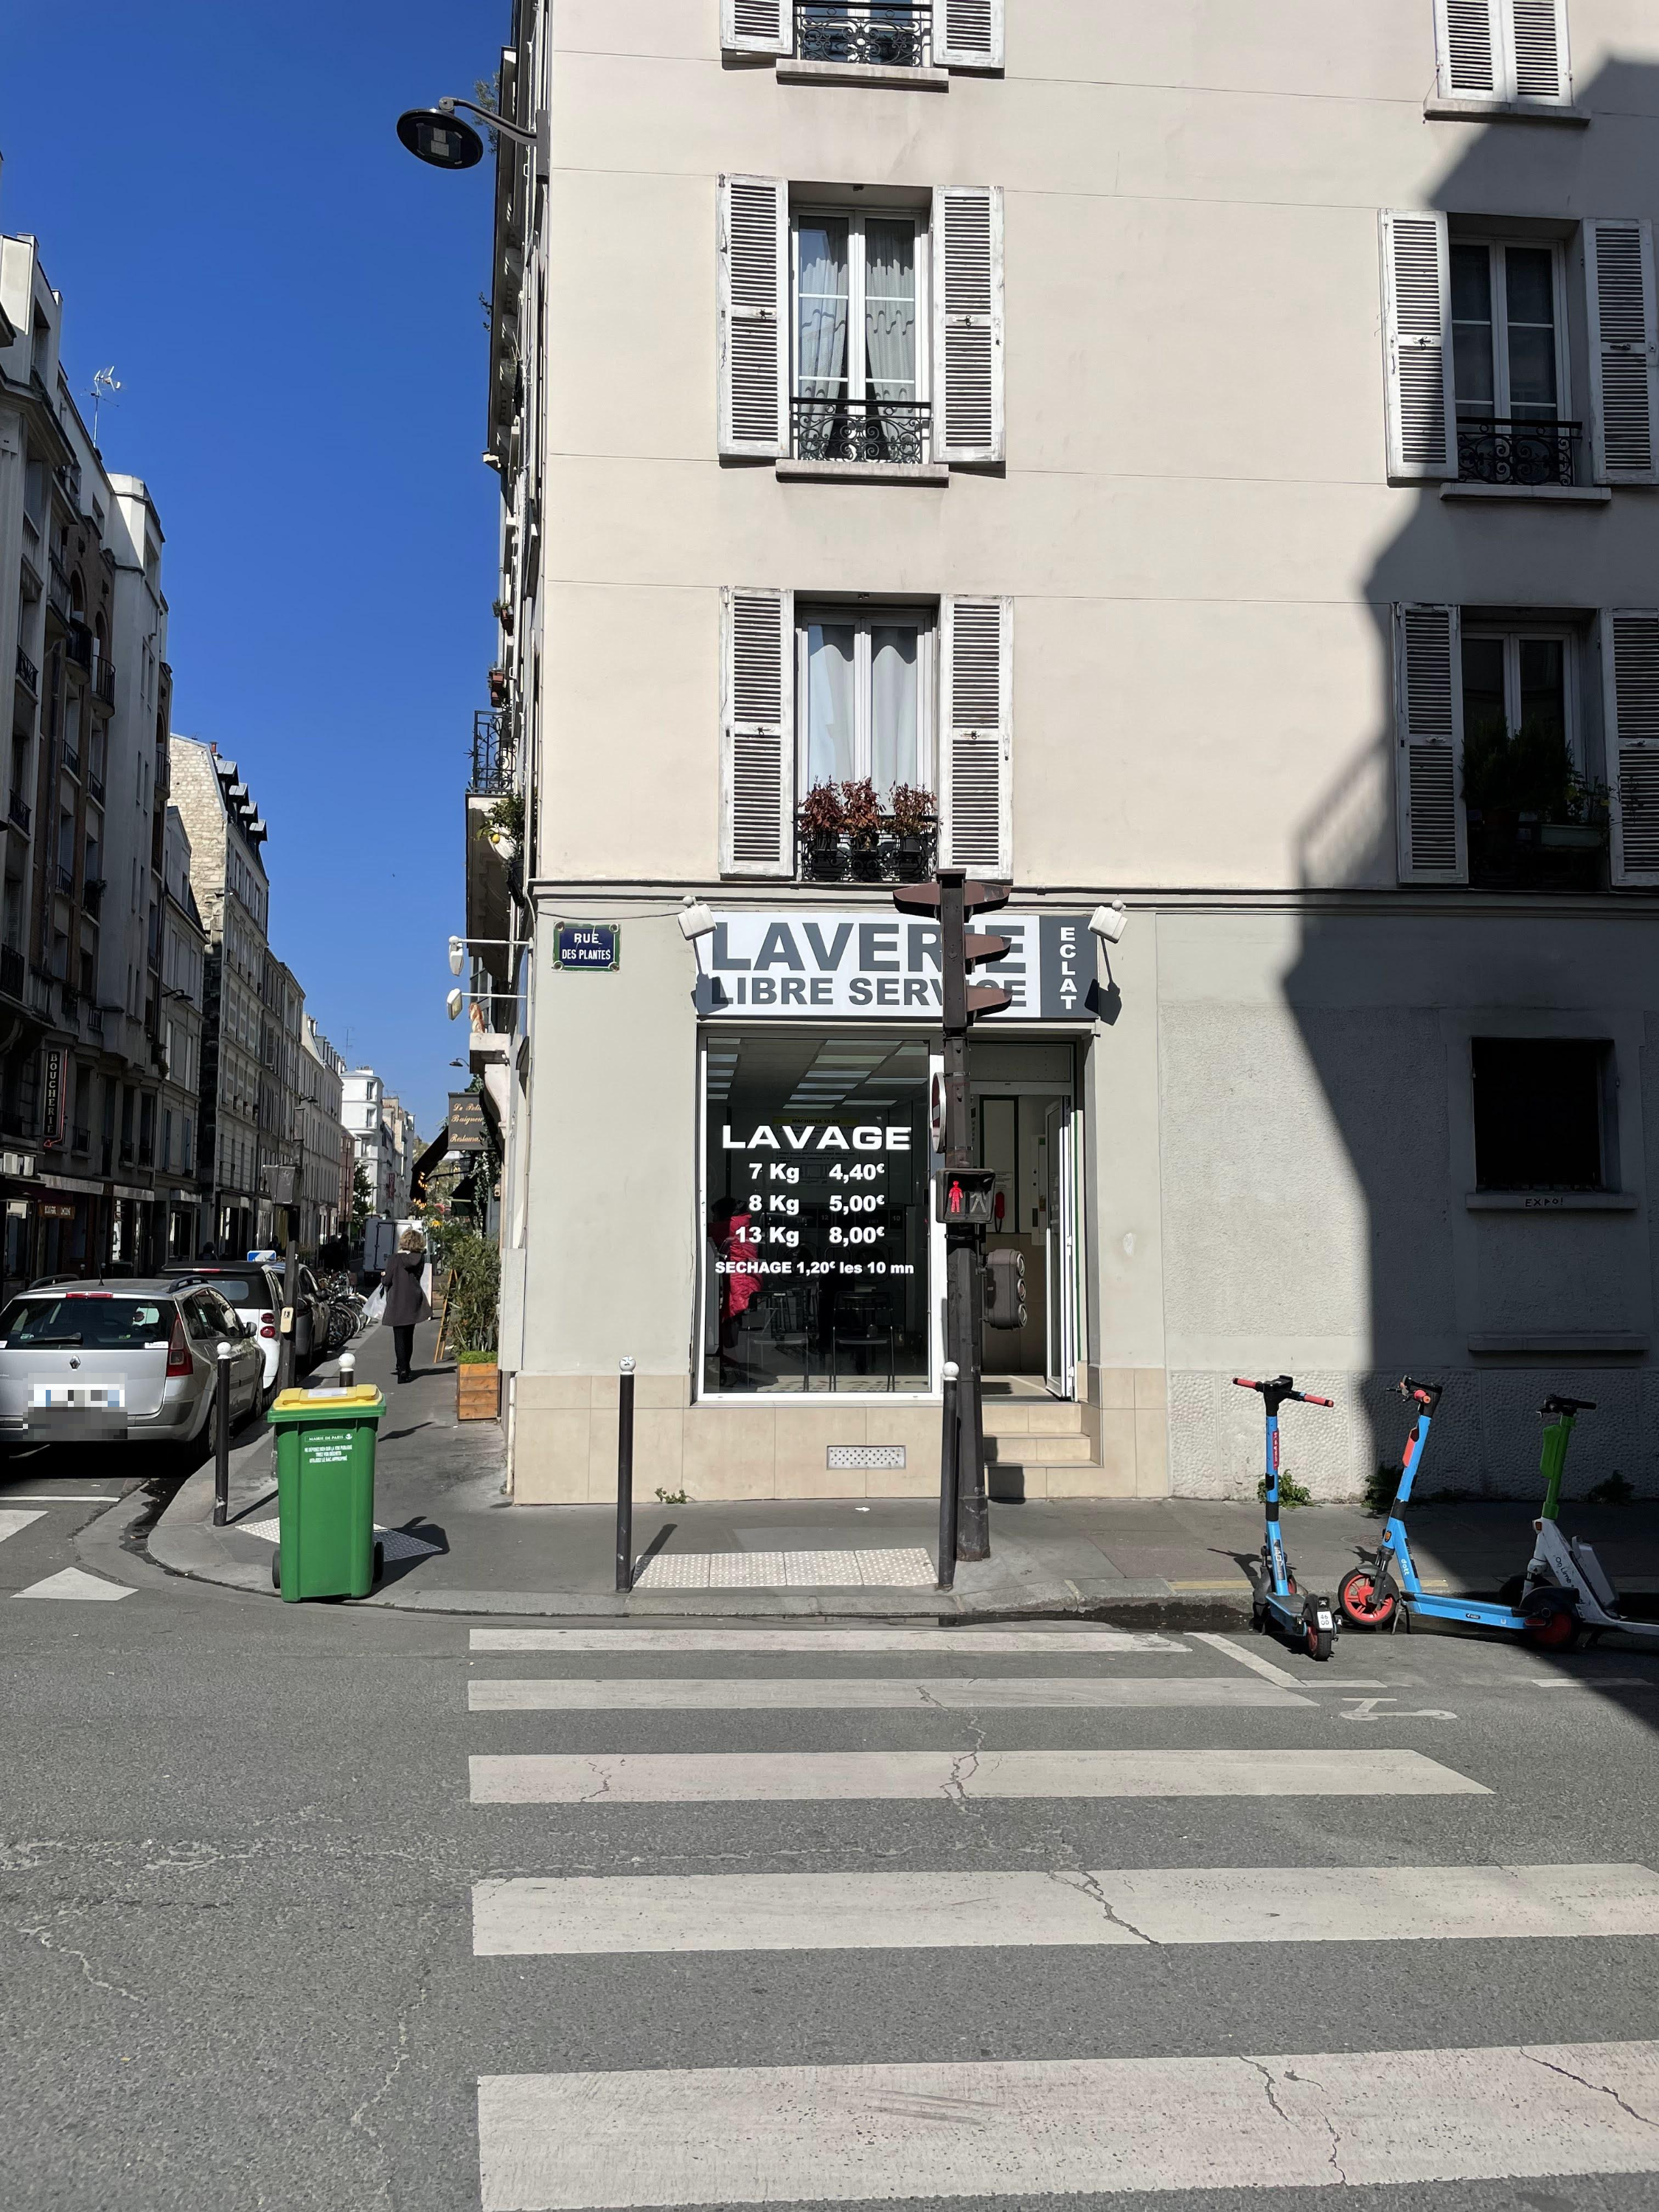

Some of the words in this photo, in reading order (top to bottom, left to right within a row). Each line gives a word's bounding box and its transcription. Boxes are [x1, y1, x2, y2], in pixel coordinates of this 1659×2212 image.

[574, 933, 599, 944] RUE
[712, 922, 1026, 973] LAVERE
[562, 949, 577, 959] DES
[579, 949, 611, 960] PLANTES
[1060, 927, 1077, 1009] ECLAT
[712, 977, 833, 1005] LIBRE
[47, 1053, 58, 1133] BOUCHERIE
[722, 1124, 912, 1150] LAVAGE
[748, 1163, 762, 1180] 7
[770, 1163, 800, 1184] Kg
[829, 1163, 885, 1184] 4,40€
[748, 1194, 762, 1211] 8
[770, 1194, 800, 1216] Kg
[829, 1194, 885, 1216] 5,00€
[1526, 1197, 1563, 1207] EXPO!
[735, 1226, 762, 1243] 13
[770, 1226, 800, 1248] Kg
[829, 1226, 885, 1248] 8,00€
[715, 1262, 792, 1274] SECHAGE
[840, 1262, 863, 1274] les
[867, 1262, 886, 1274] 10
[891, 1264, 914, 1274] mn
[1401, 1558, 1410, 1576] dott
[1560, 1568, 1572, 1584] Lime
